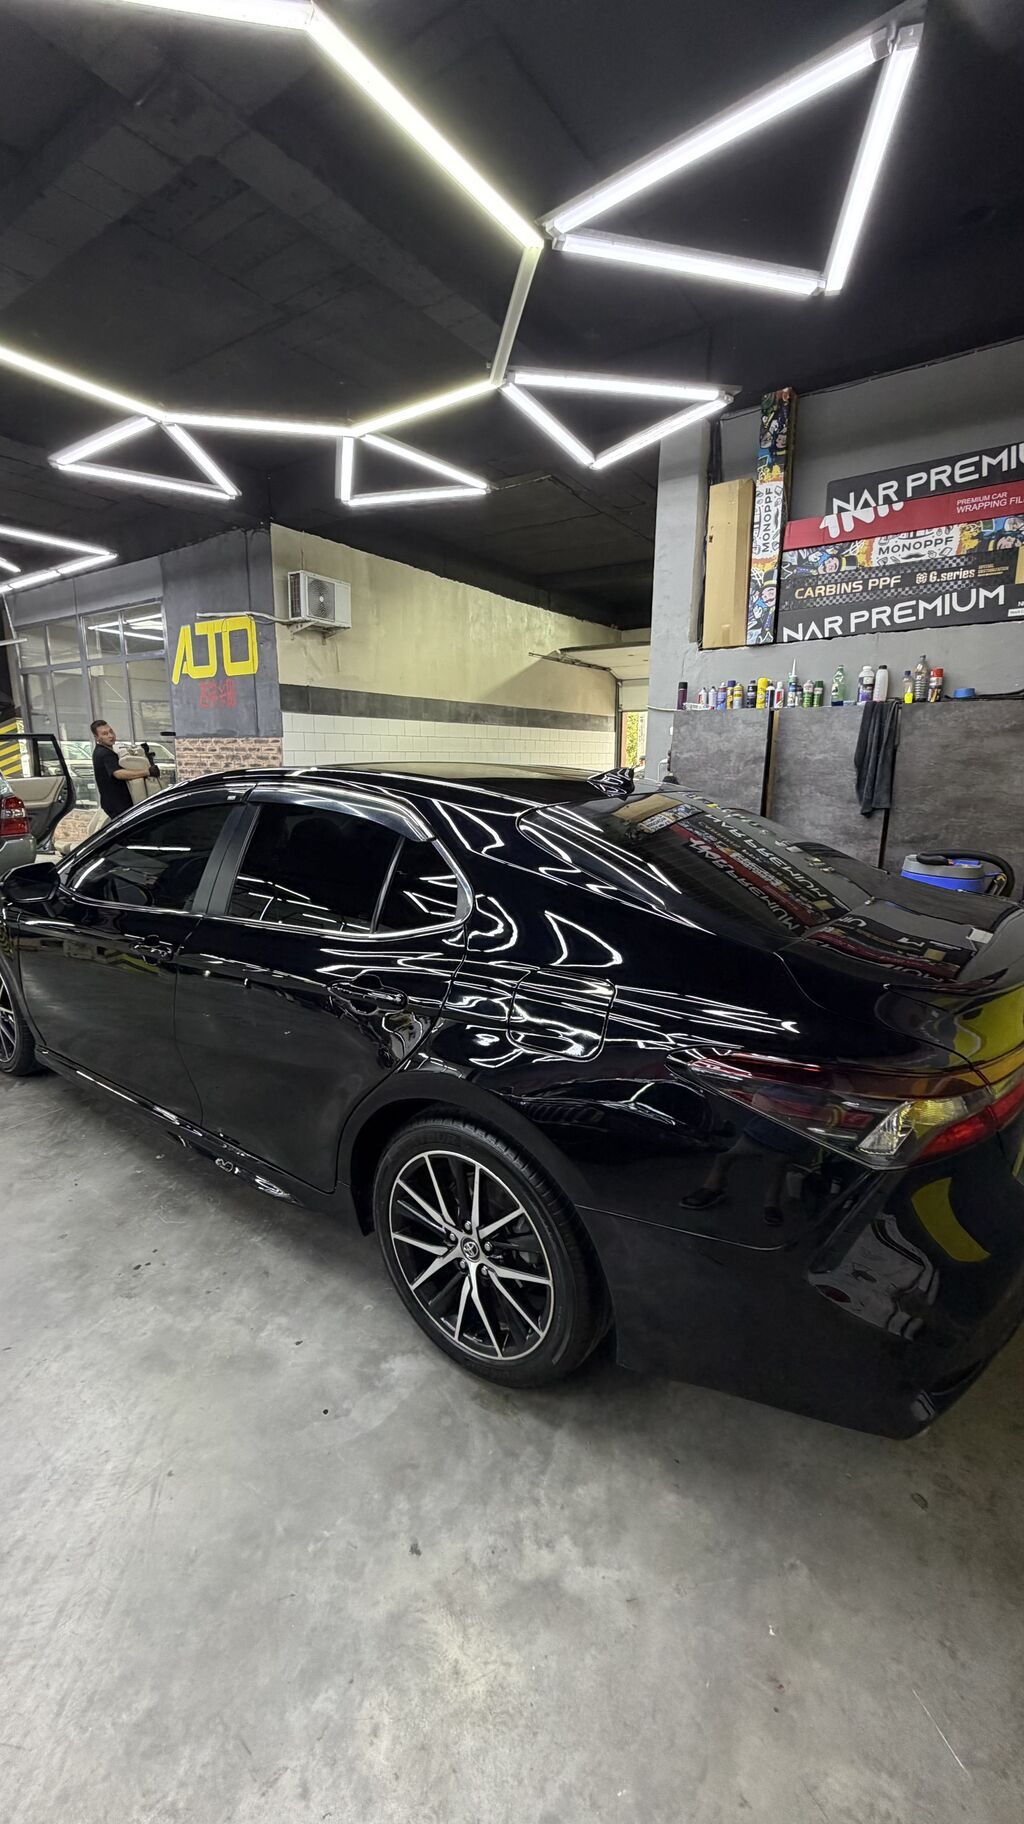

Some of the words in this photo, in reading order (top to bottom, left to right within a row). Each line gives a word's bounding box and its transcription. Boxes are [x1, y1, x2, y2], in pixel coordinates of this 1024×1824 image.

[832, 480, 899, 515] NAR
[906, 442, 1024, 498] PREMI
[956, 494, 991, 506] PREMIUM
[991, 491, 1008, 500] CAR
[956, 498, 1007, 514] WRAPPING
[1009, 496, 1024, 505] FIL
[762, 487, 774, 553] MONOPPF
[878, 536, 954, 555] MONOPPF
[794, 580, 863, 600] CARBINS
[868, 575, 902, 591] PPF
[929, 568, 976, 583] G.series
[783, 615, 844, 643] NAR
[850, 584, 1005, 633] PREMIUM
